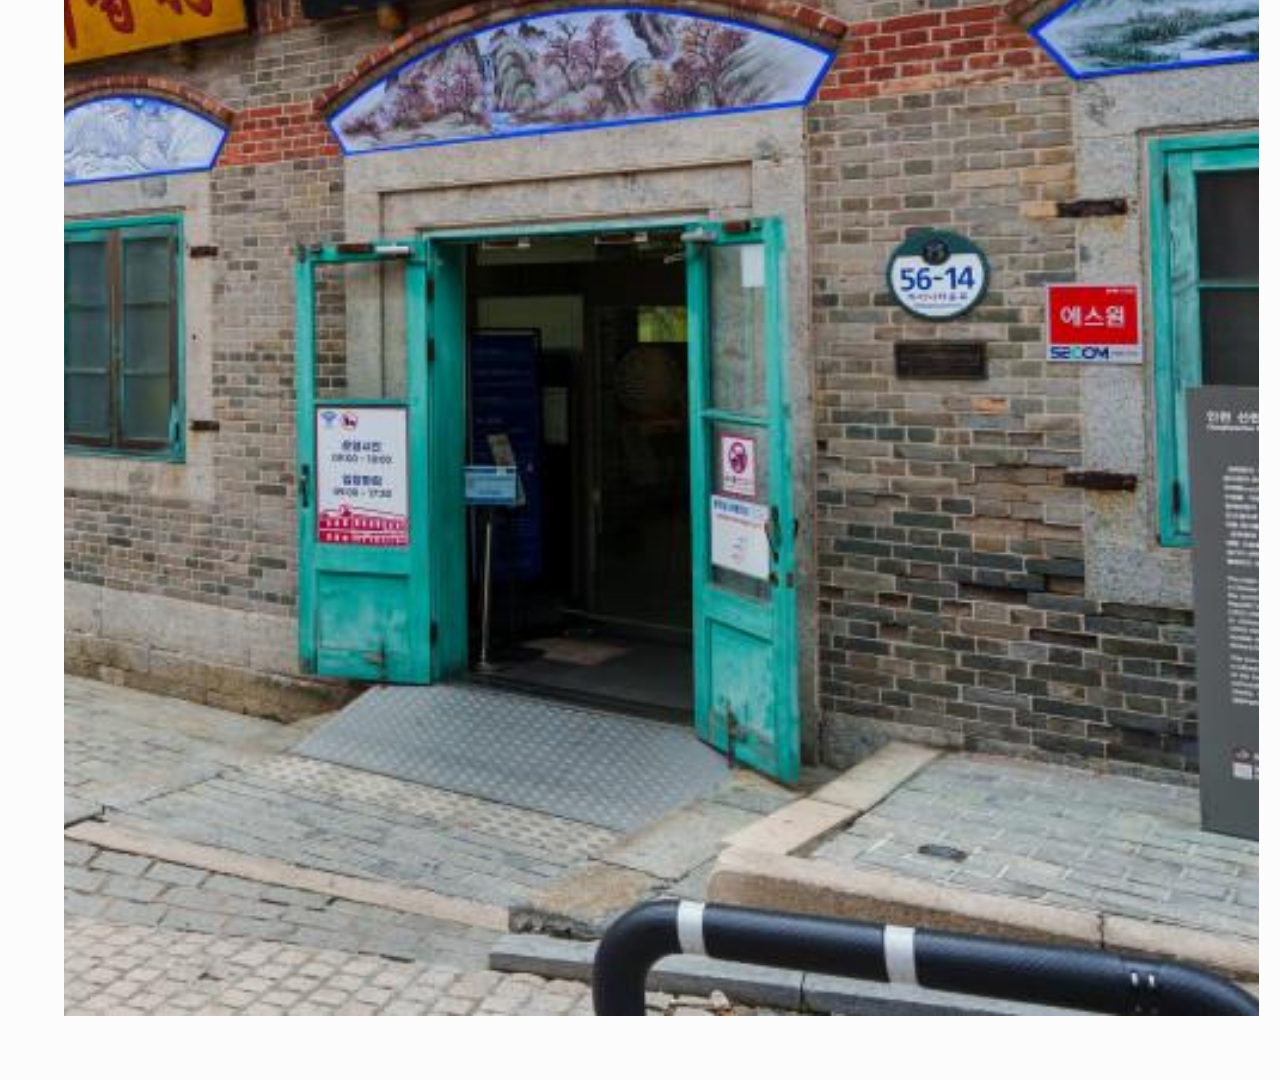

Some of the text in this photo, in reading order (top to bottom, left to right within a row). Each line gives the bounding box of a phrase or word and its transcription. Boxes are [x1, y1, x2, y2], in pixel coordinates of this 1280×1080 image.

[900, 266, 976, 291] 56-14
[1060, 306, 1124, 328] 에스원
[1050, 346, 1109, 359] SECOM
